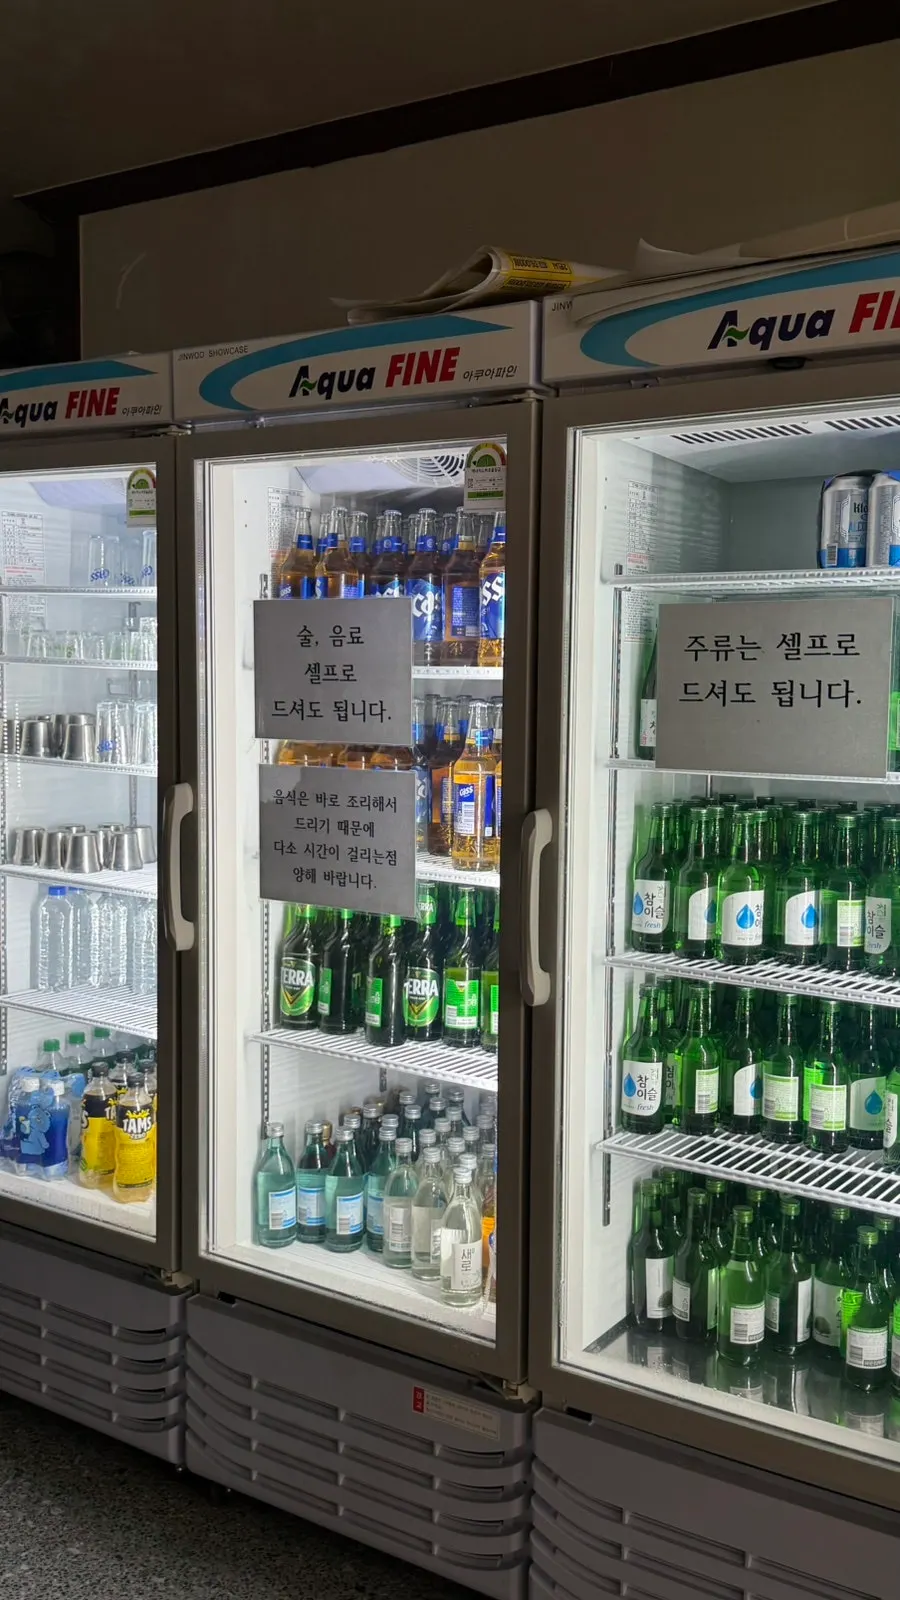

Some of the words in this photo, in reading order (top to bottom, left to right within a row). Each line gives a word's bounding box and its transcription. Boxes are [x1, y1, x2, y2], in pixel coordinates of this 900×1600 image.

[707, 309, 836, 351] Aqua
[848, 290, 900, 334] FI
[177, 351, 205, 361] JINWOO
[208, 345, 248, 358] SHOWCASE
[288, 365, 376, 400] Aqua
[385, 346, 461, 388] FINE
[463, 364, 518, 382] 아쿠아파인
[65, 387, 120, 419] FINE
[122, 404, 163, 417] 아쿠아파인
[297, 625, 319, 648] 술,
[329, 625, 364, 648] 음료
[684, 634, 762, 662] 주류는
[776, 632, 861, 661] 셀프로
[304, 662, 357, 685] 셀프로
[679, 679, 756, 707] 드셔도
[771, 679, 862, 708] 됩니다.
[272, 699, 324, 721] 드셔도
[333, 699, 392, 723] 됩니다.
[273, 788, 309, 807] 음식은
[315, 791, 340, 808] 바로
[347, 794, 398, 813] 조리해서
[294, 817, 330, 834] 드리기
[337, 819, 375, 838] 때문에
[273, 840, 297, 855] 다소
[304, 842, 340, 860] 시간이
[347, 846, 397, 867] 걸리는점
[323, 870, 377, 890] 바랍니다.
[403, 979, 440, 999] TERRA
[636, 1074, 658, 1102] 참이슬
[104, 1105, 117, 1121] TA
[122, 1116, 153, 1135] TAMS
